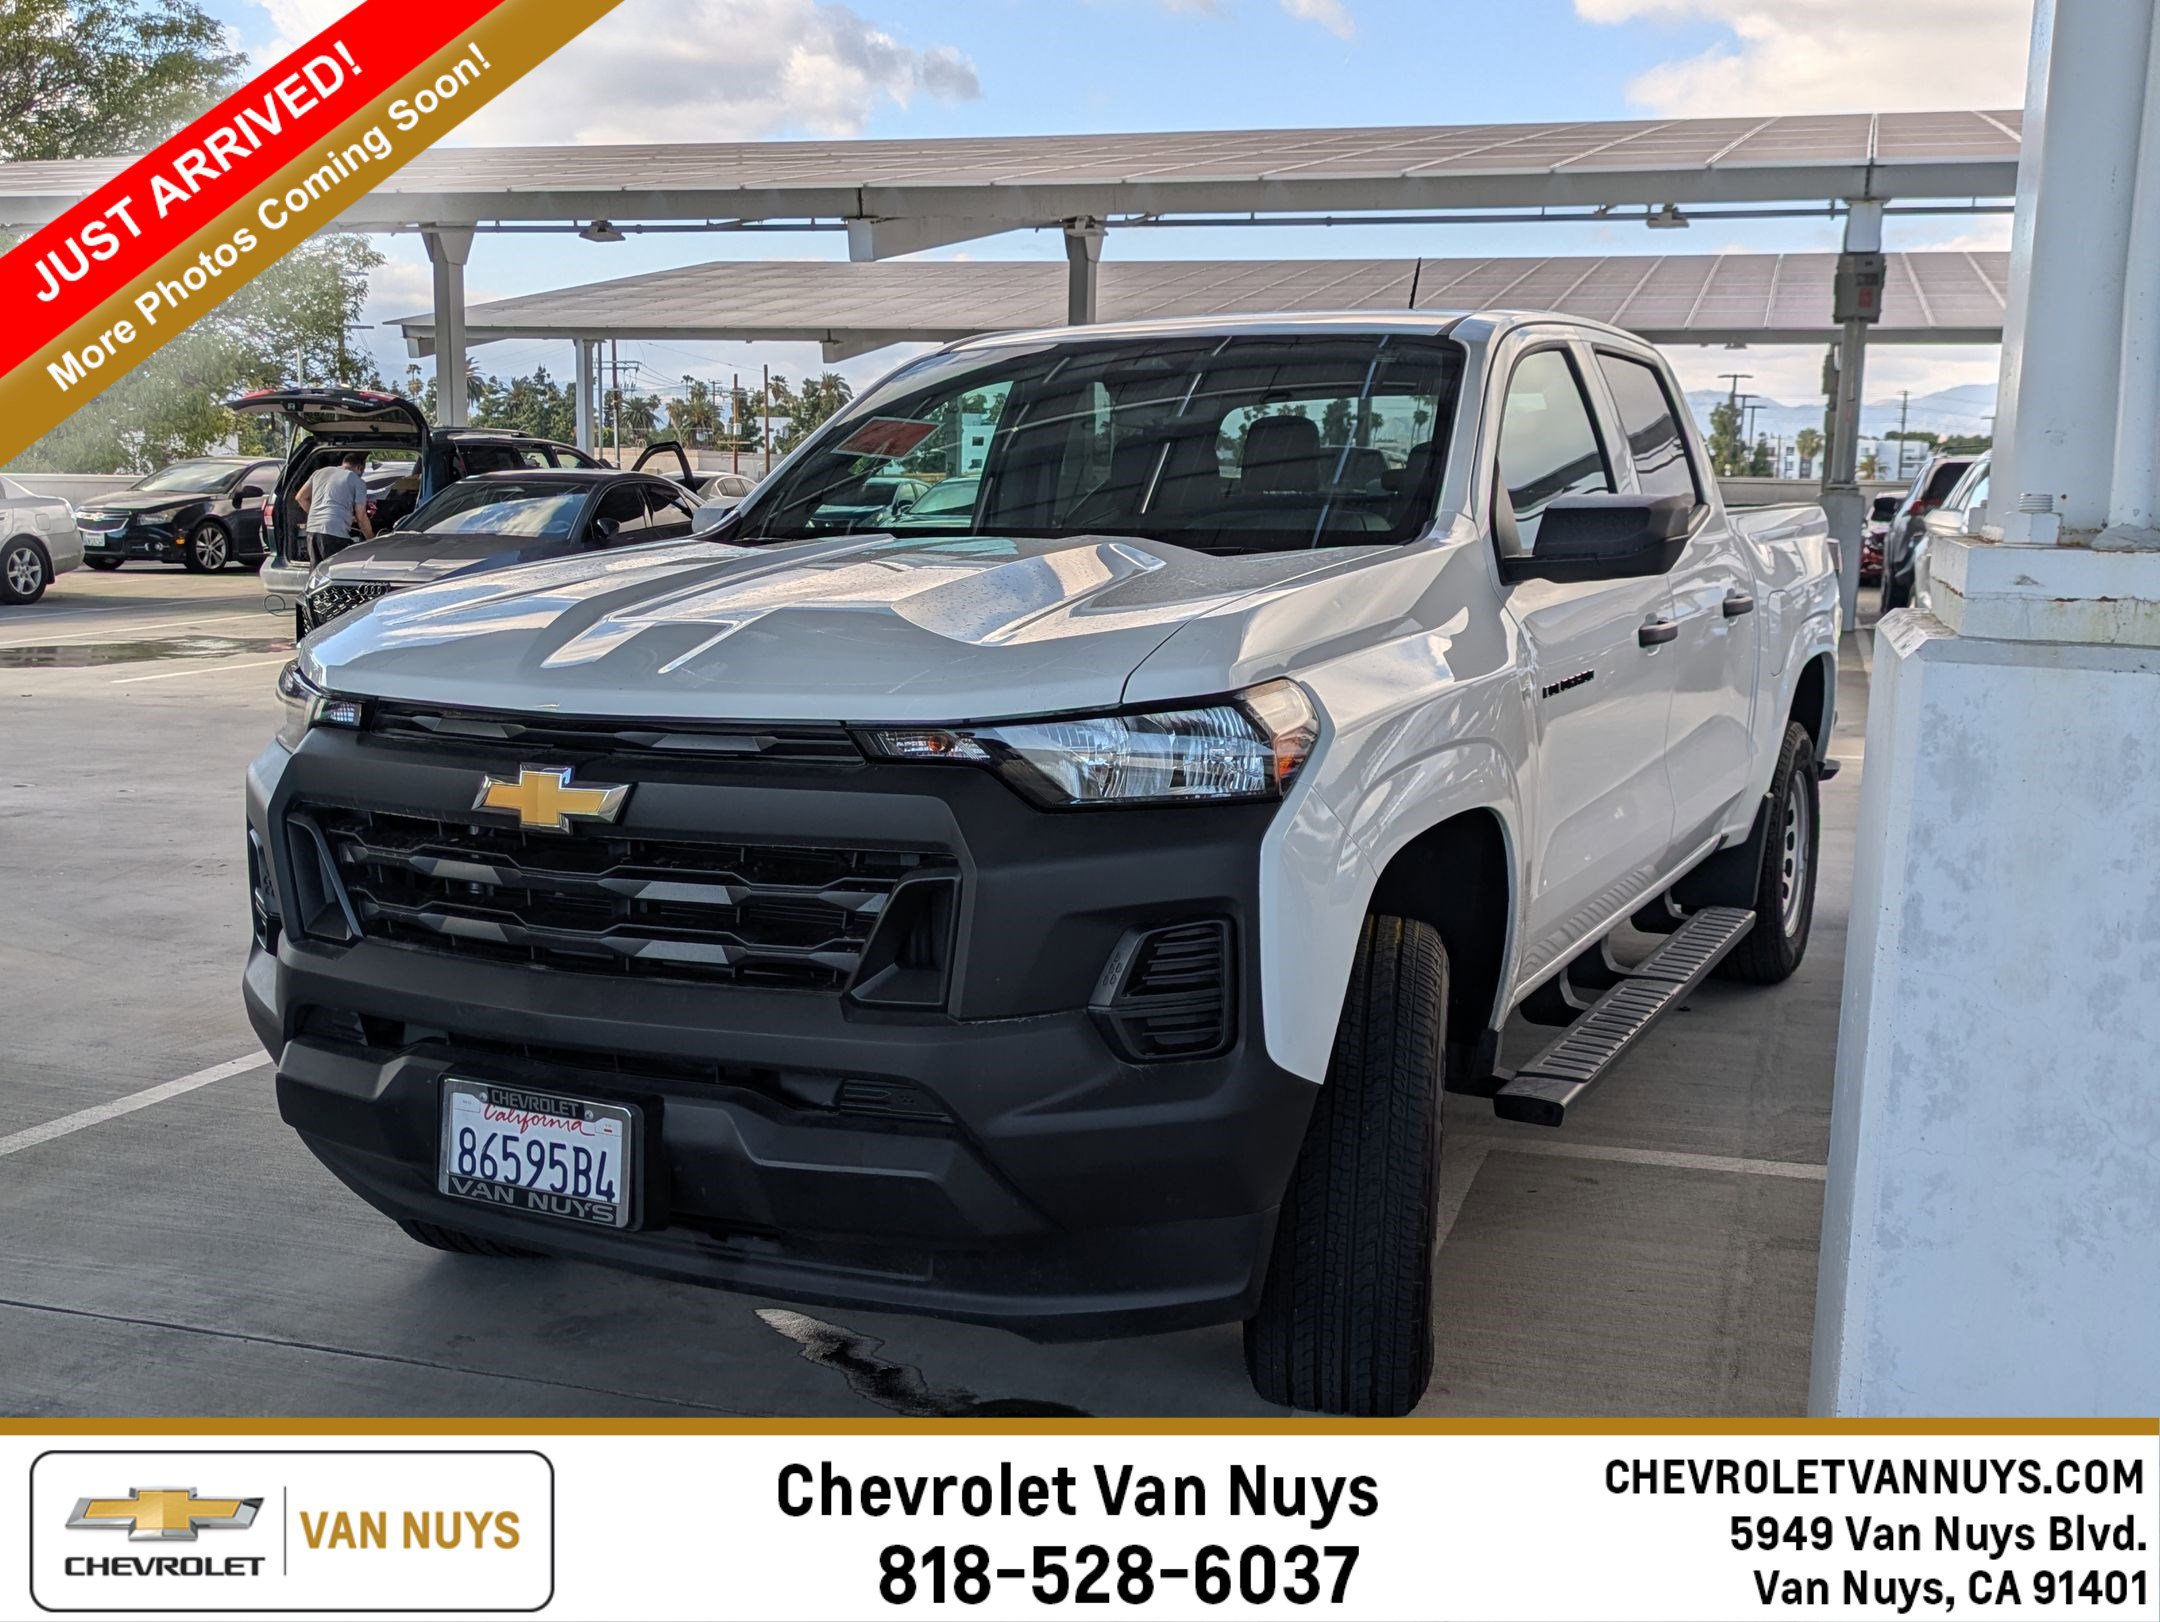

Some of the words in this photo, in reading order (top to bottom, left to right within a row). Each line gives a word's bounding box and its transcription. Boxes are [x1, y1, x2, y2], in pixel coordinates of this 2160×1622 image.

[484, 1103, 595, 1136] California
[491, 1089, 579, 1117] CHEVROLET
[458, 1127, 616, 1203] 86595B4
[452, 1177, 514, 1205] VAN
[528, 1191, 615, 1223] NUYS
